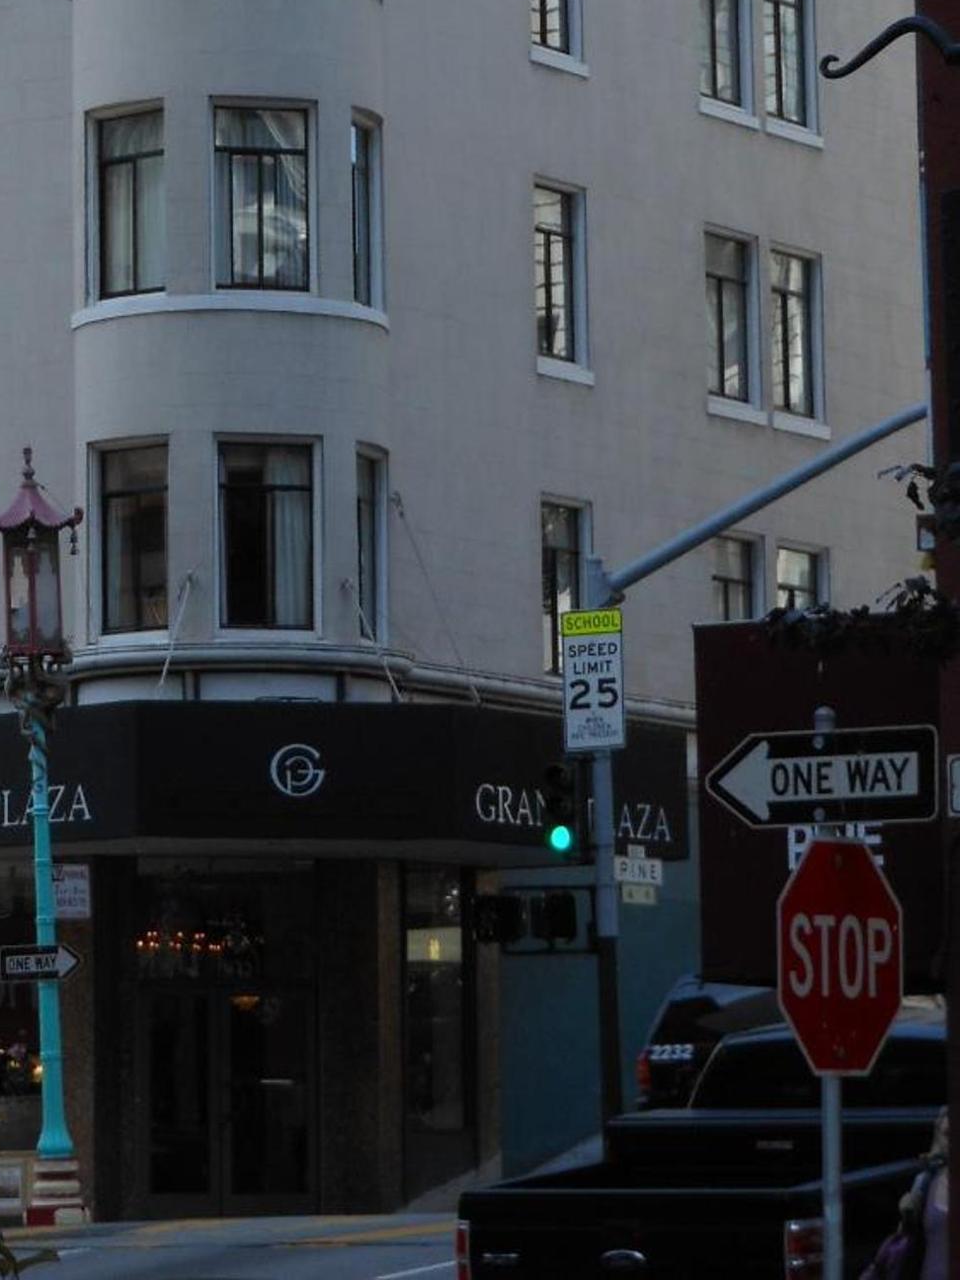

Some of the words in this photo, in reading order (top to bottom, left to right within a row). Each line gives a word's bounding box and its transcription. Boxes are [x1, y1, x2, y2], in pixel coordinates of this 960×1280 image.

[566, 613, 619, 631] SCHOOL
[568, 642, 618, 658] SPEED
[573, 660, 614, 675] LIMIT
[569, 677, 619, 710] 25
[770, 761, 833, 797] ONE
[846, 757, 910, 794] WAY
[475, 783, 548, 827] GRA
[8, 956, 32, 971] ONE
[35, 955, 57, 970] WAY
[789, 913, 892, 999] STOP
